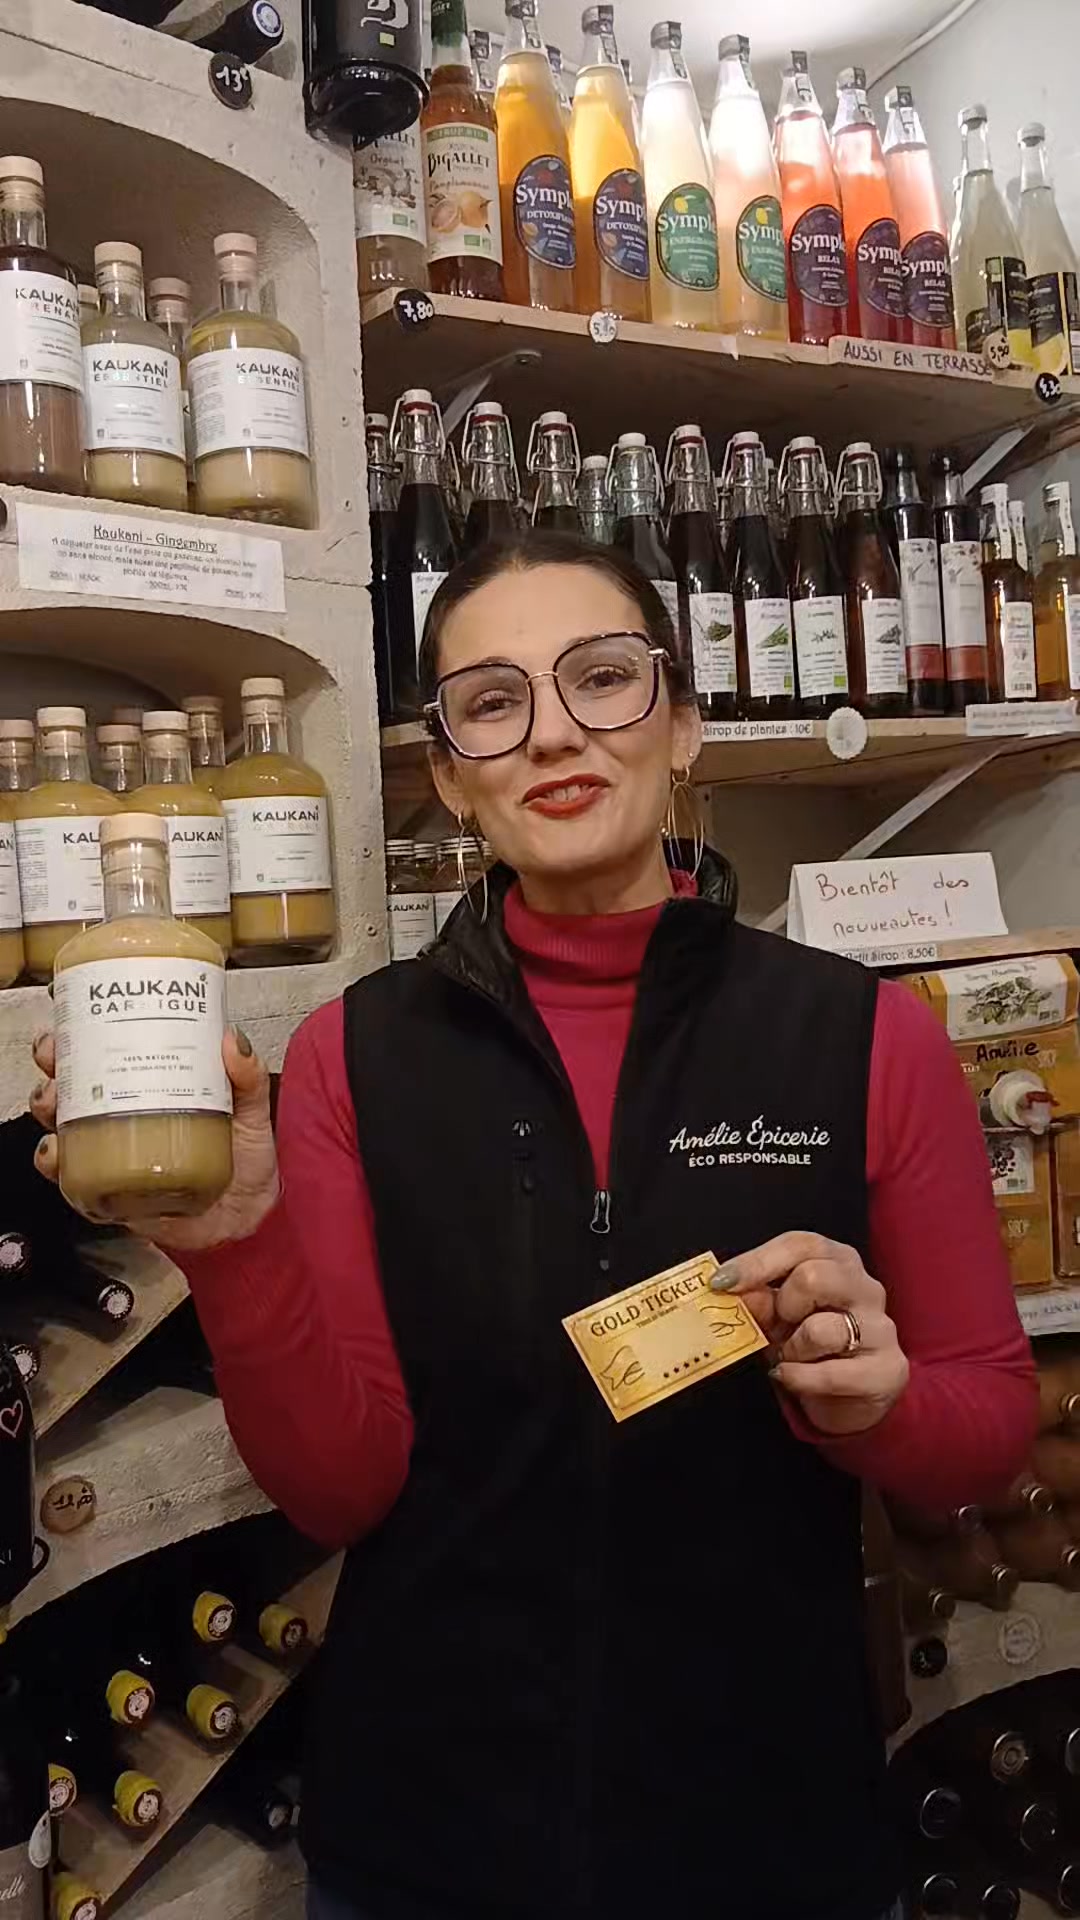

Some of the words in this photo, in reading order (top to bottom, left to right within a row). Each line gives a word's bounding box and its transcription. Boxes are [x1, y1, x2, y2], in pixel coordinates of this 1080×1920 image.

[399, 300, 434, 323] 7,80
[843, 342, 882, 362] AUSSI
[893, 350, 914, 367] EN
[923, 353, 993, 376] TERRASSE
[93, 524, 143, 543] Kaukani
[735, 724, 747, 735] de
[750, 723, 787, 738] plantes
[795, 724, 811, 734] 10€
[815, 870, 900, 901] Bientôt
[933, 871, 969, 890] des
[91, 1000, 207, 1016] GARIGUE
[669, 1121, 742, 1153] Amélie
[746, 1114, 831, 1151] Épicerie
[688, 1153, 715, 1168] ÉCO
[719, 1152, 812, 1165] RESPONSABLE
[590, 1304, 641, 1337] GOLD
[641, 1272, 709, 1313] TICKET
